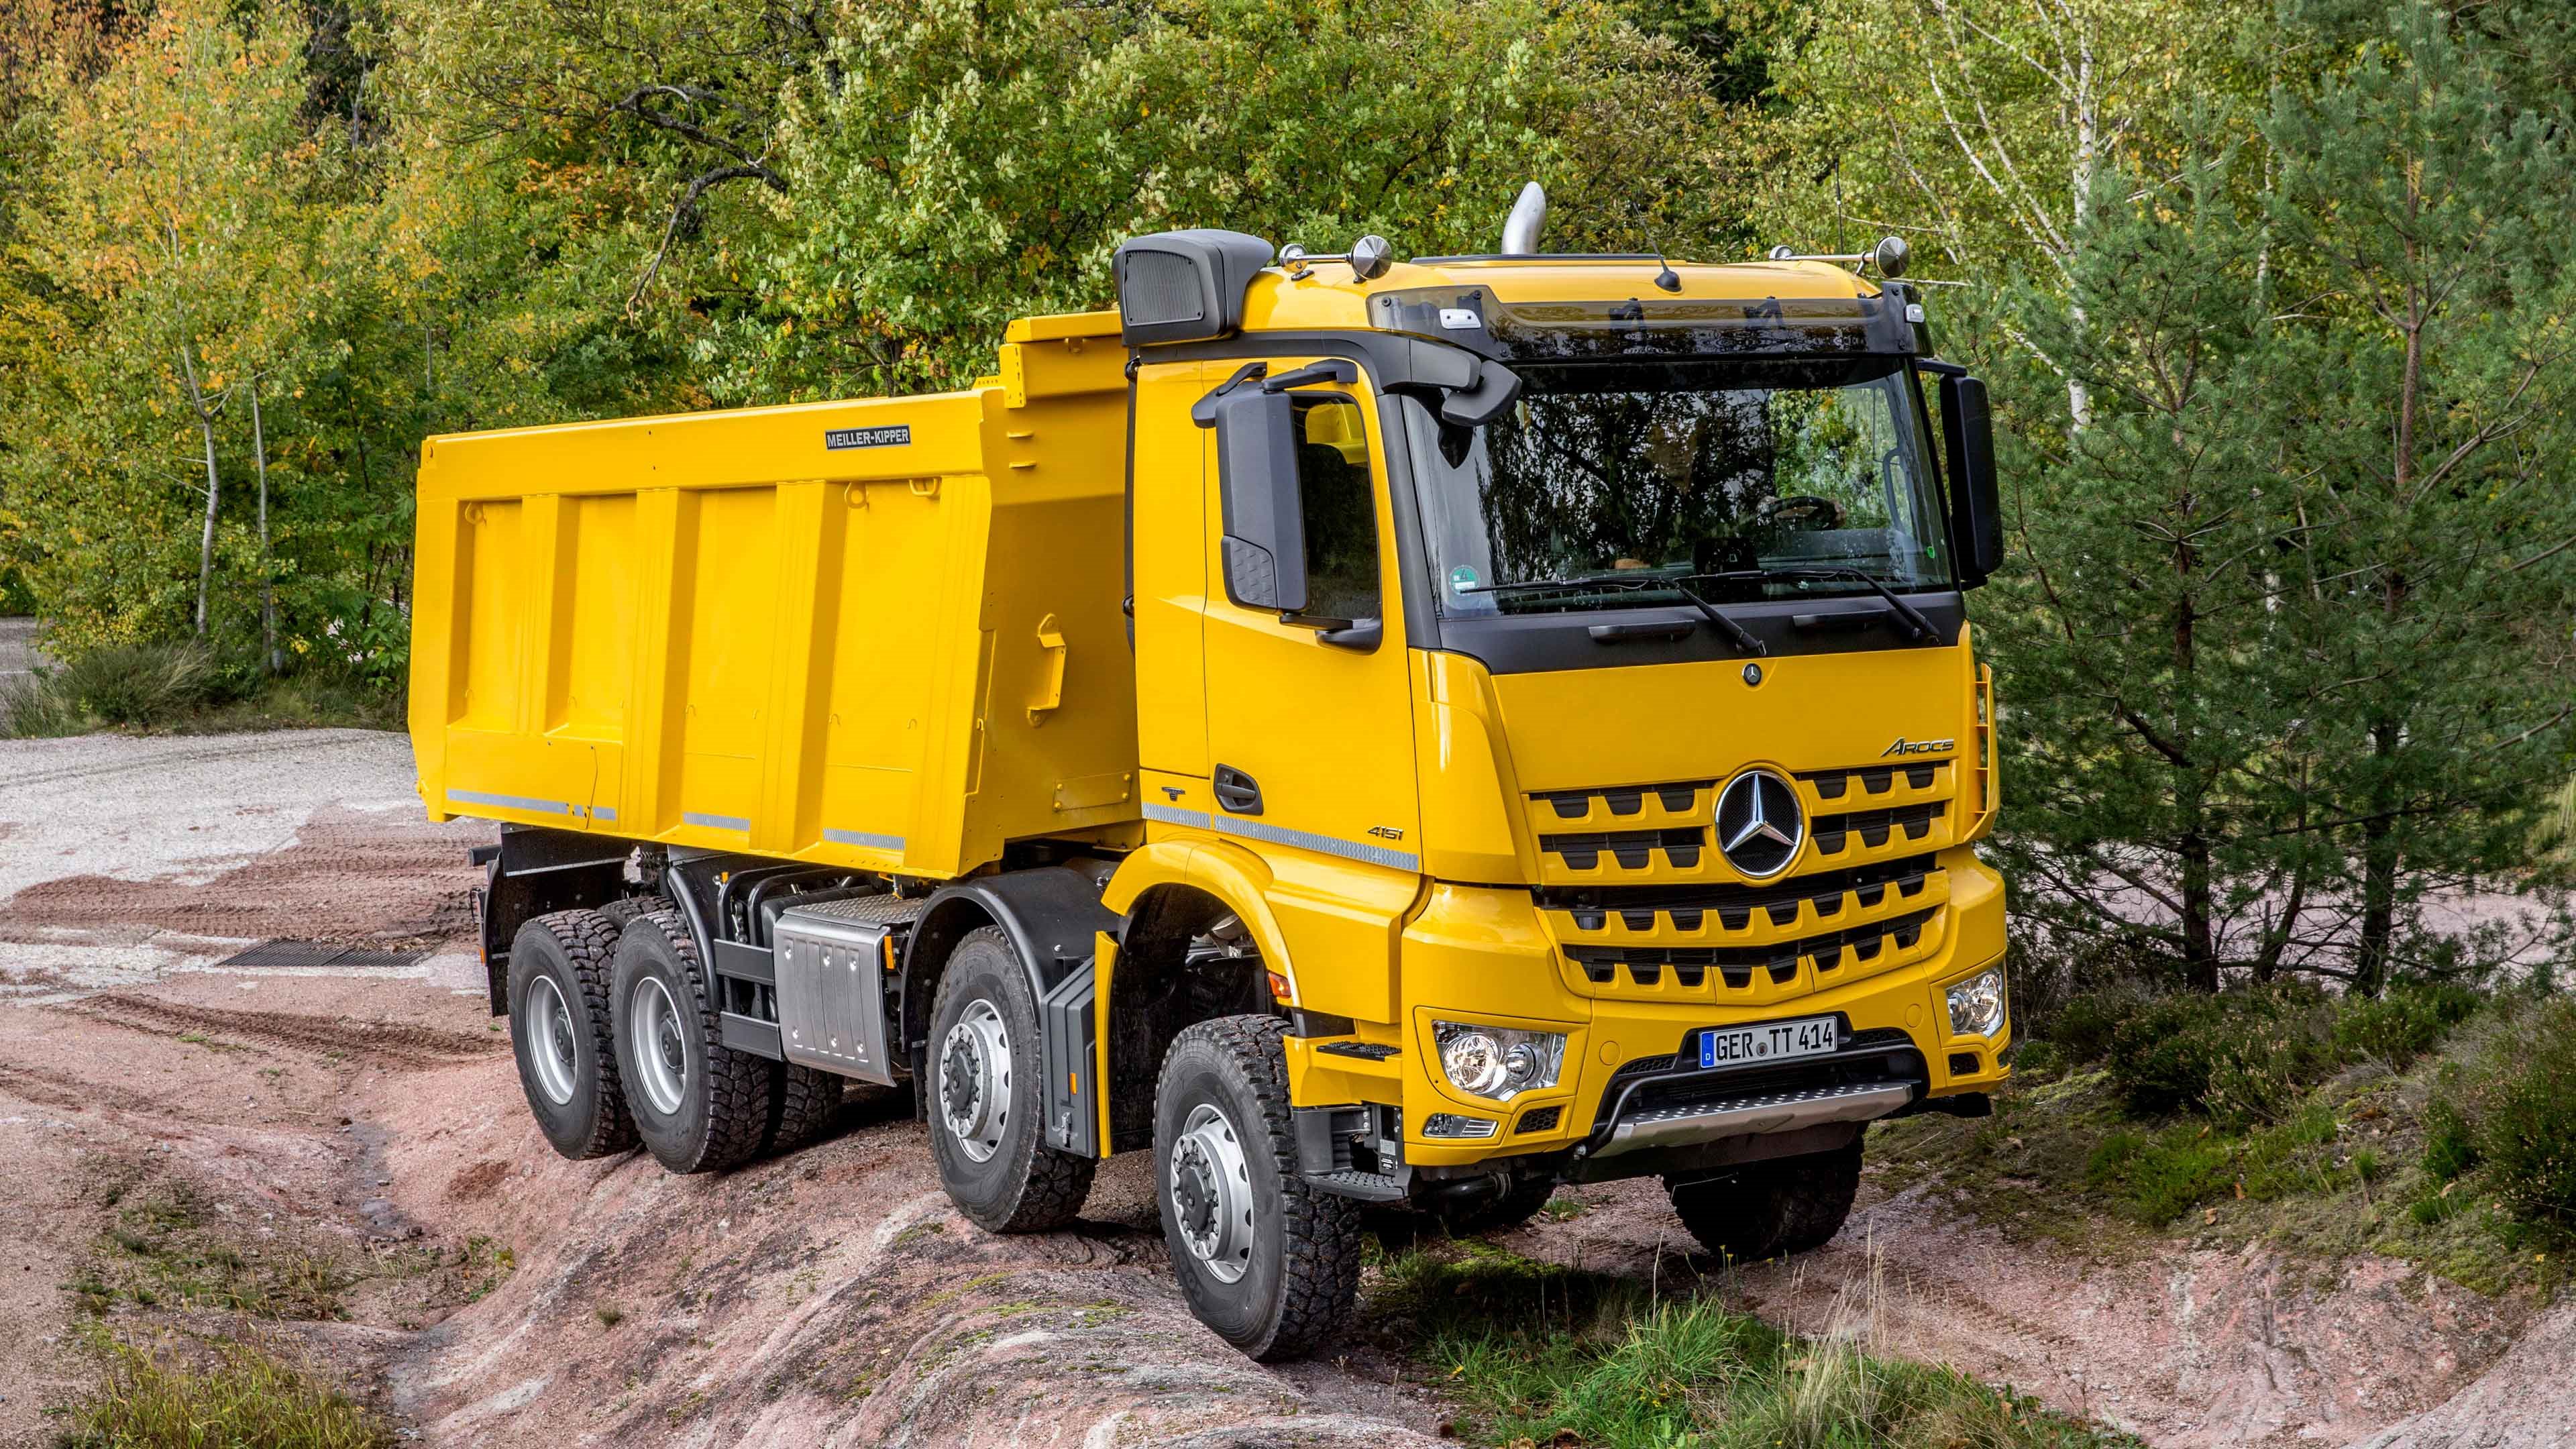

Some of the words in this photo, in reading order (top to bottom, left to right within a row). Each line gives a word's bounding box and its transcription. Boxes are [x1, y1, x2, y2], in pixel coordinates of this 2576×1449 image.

[826, 429, 910, 447] MEILLER-KIPPER
[1716, 1032, 1754, 1061] GER
[1769, 1027, 1793, 1054] TT
[1799, 1022, 1833, 1051] 414
[1705, 1053, 1711, 1061] D
